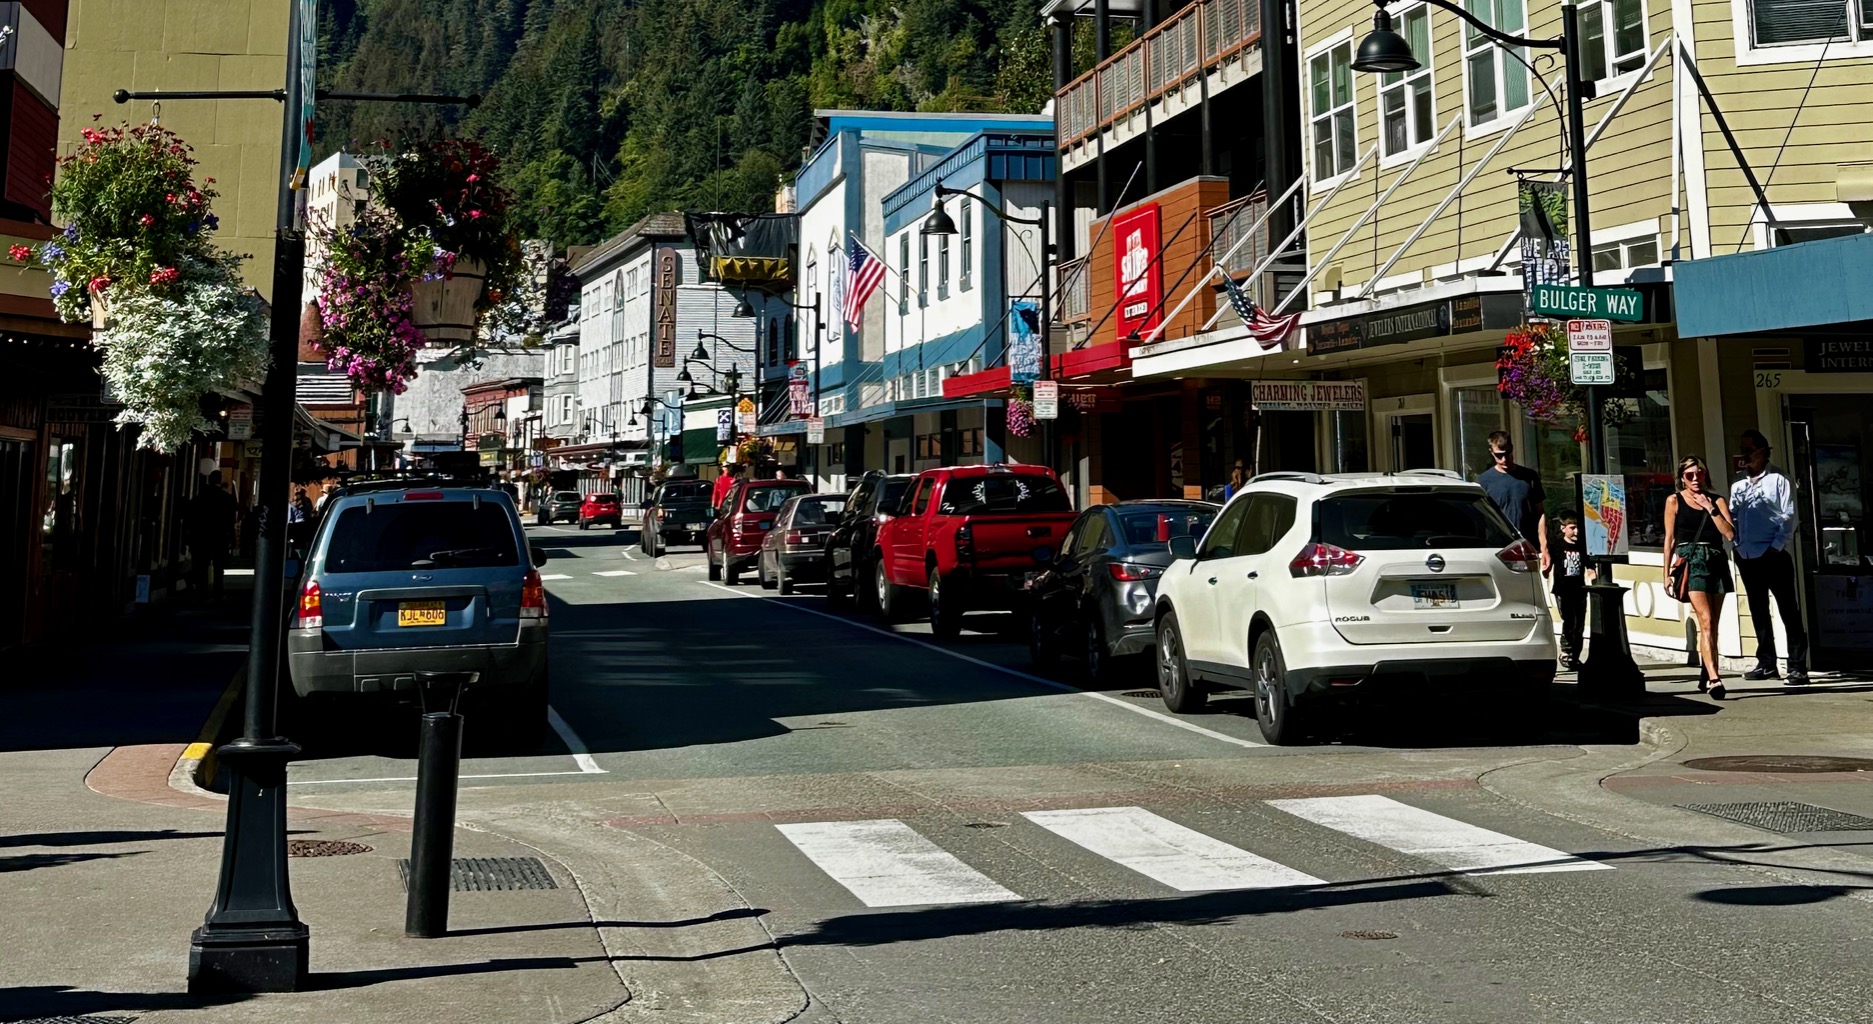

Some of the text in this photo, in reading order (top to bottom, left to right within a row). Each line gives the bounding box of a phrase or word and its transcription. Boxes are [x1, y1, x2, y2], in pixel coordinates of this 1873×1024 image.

[658, 256, 674, 358] SENATE
[1540, 289, 1638, 315] BULGER WAY
[1818, 341, 1873, 356] JEWEL
[1756, 373, 1781, 388] 265
[1252, 384, 1363, 402] CHARMING JEWELERS
